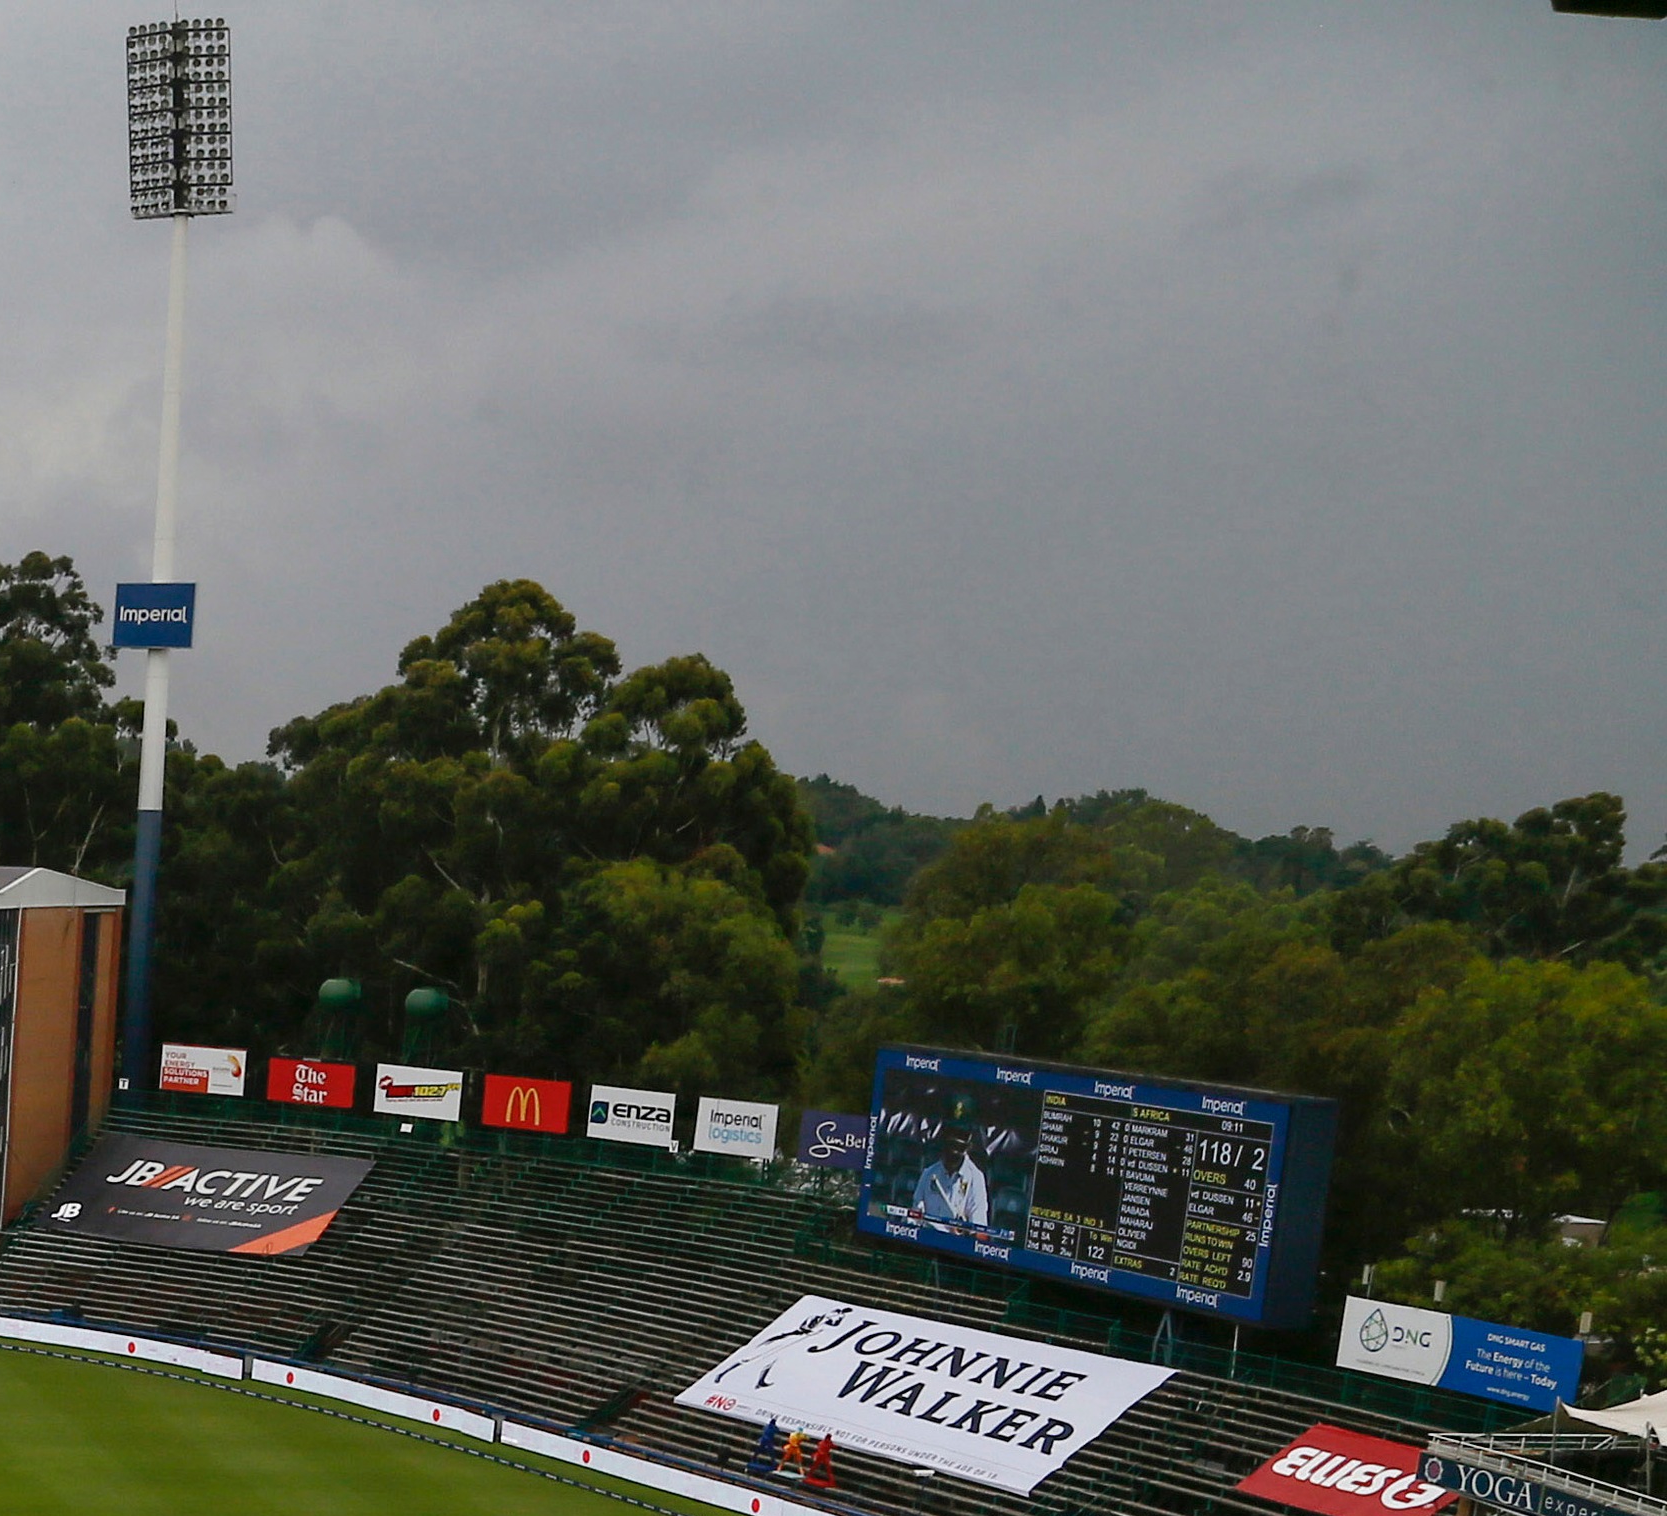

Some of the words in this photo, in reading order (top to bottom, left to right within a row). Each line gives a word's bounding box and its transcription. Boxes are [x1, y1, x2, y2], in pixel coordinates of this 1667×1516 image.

[120, 606, 187, 625] Imperial
[906, 1055, 939, 1072] Imperial
[295, 1063, 327, 1085] The
[996, 1067, 1031, 1086] Imperial
[291, 1083, 329, 1105] Star
[1094, 1081, 1134, 1100] Imperial
[1140, 1108, 1171, 1122] AFRICA
[1201, 1096, 1244, 1117] Imperial
[611, 1118, 671, 1133] CONSTRUCTION
[710, 1109, 763, 1130] Imperial
[1222, 1120, 1244, 1133] 09:11
[708, 1124, 762, 1144] logistics
[864, 1115, 879, 1170] Imperial
[1130, 1135, 1155, 1148] ELGAR
[1128, 1147, 1167, 1161] PETERSEN
[1193, 1169, 1227, 1185] OVERS
[184, 1195, 211, 1209] we
[214, 1199, 249, 1212] are
[249, 1201, 302, 1217] sport
[1189, 1203, 1215, 1216] ELGAR
[1259, 1183, 1279, 1248] Imperial
[886, 1220, 918, 1240] Imperial
[974, 1241, 1009, 1261] Imperial
[1071, 1262, 1109, 1284] Imperial
[1176, 1285, 1218, 1308] Imperial
[1530, 1341, 1547, 1352] GAS
[809, 1321, 1089, 1405] JOHNNIE
[1476, 1348, 1493, 1360] The
[1493, 1352, 1524, 1368] Energy
[1524, 1359, 1534, 1369] of
[1534, 1361, 1551, 1373] the
[1465, 1360, 1494, 1374] Future
[1502, 1368, 1523, 1381] here
[1531, 1374, 1558, 1390] Today
[837, 1361, 1074, 1457] WALKER
[1456, 1463, 1533, 1511] YOGA
